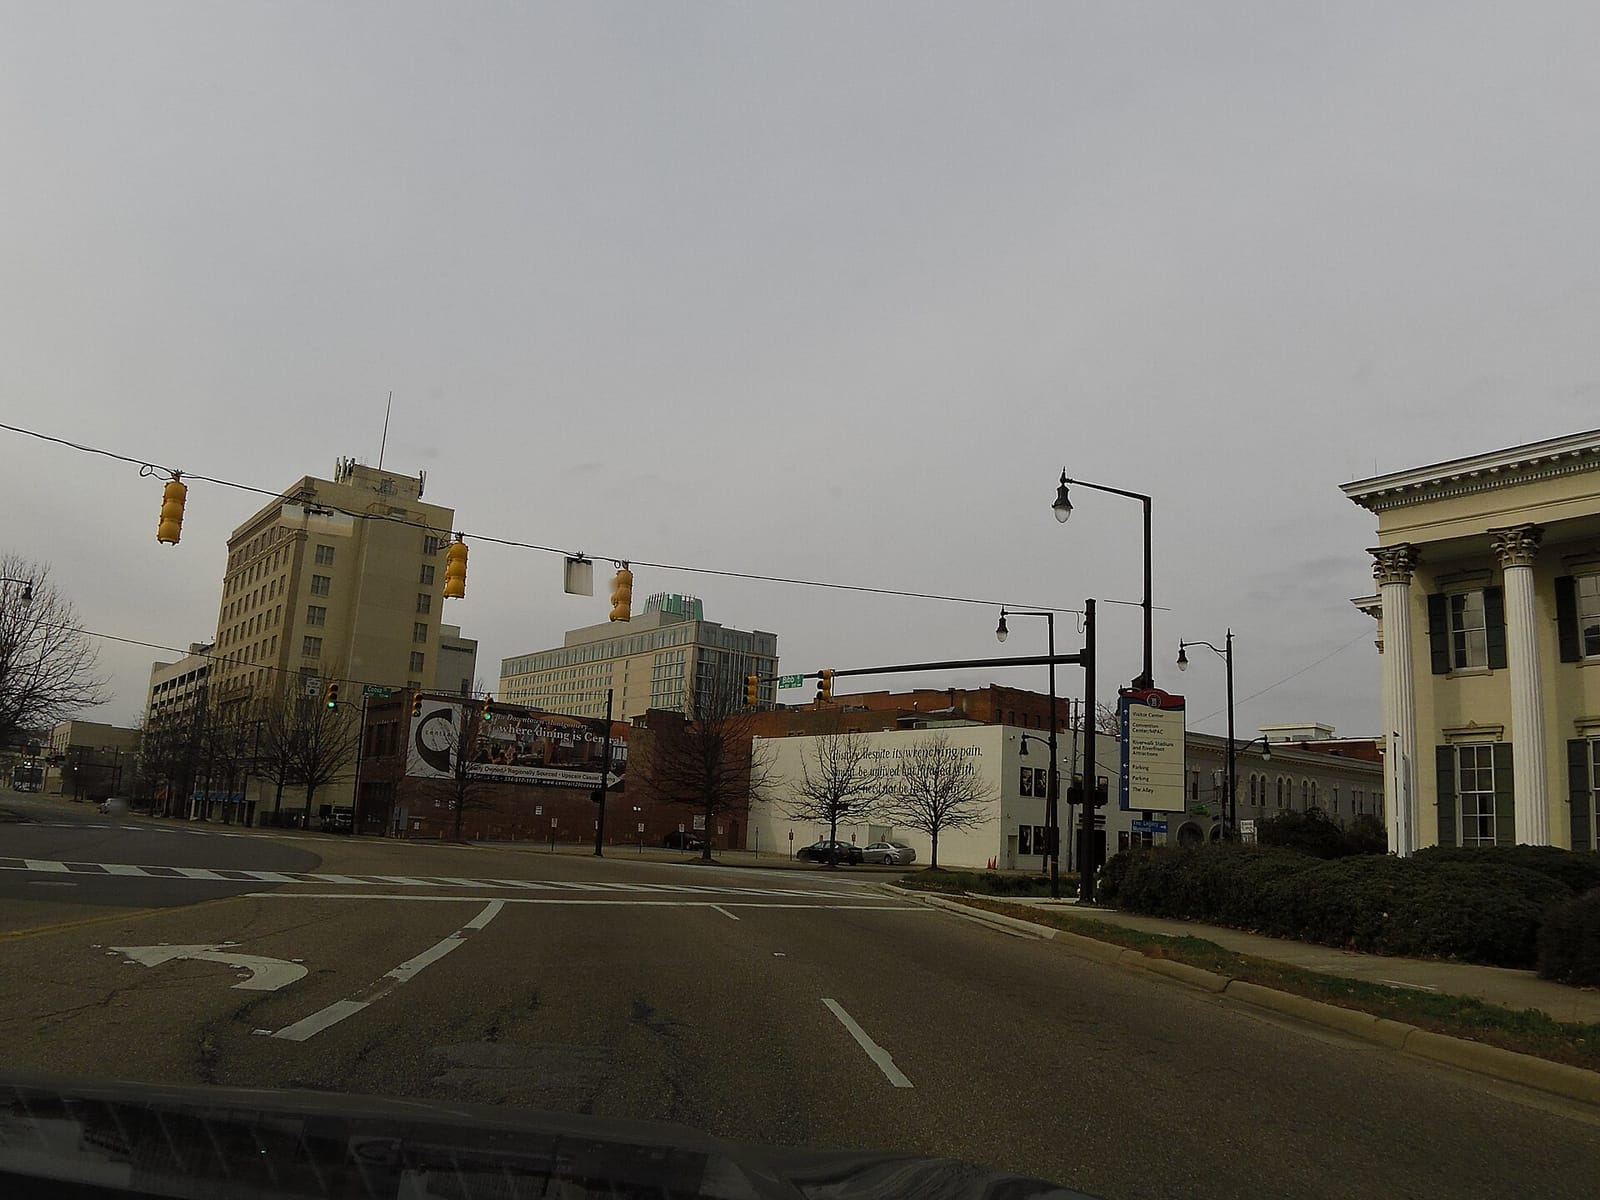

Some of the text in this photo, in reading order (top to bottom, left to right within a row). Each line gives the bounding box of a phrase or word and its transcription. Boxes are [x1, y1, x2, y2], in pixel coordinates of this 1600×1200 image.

[499, 723, 624, 747] where dining is Cenral
[863, 747, 889, 763] despite
[892, 748, 902, 759] its
[905, 745, 957, 761] wrenching
[858, 766, 868, 777] be
